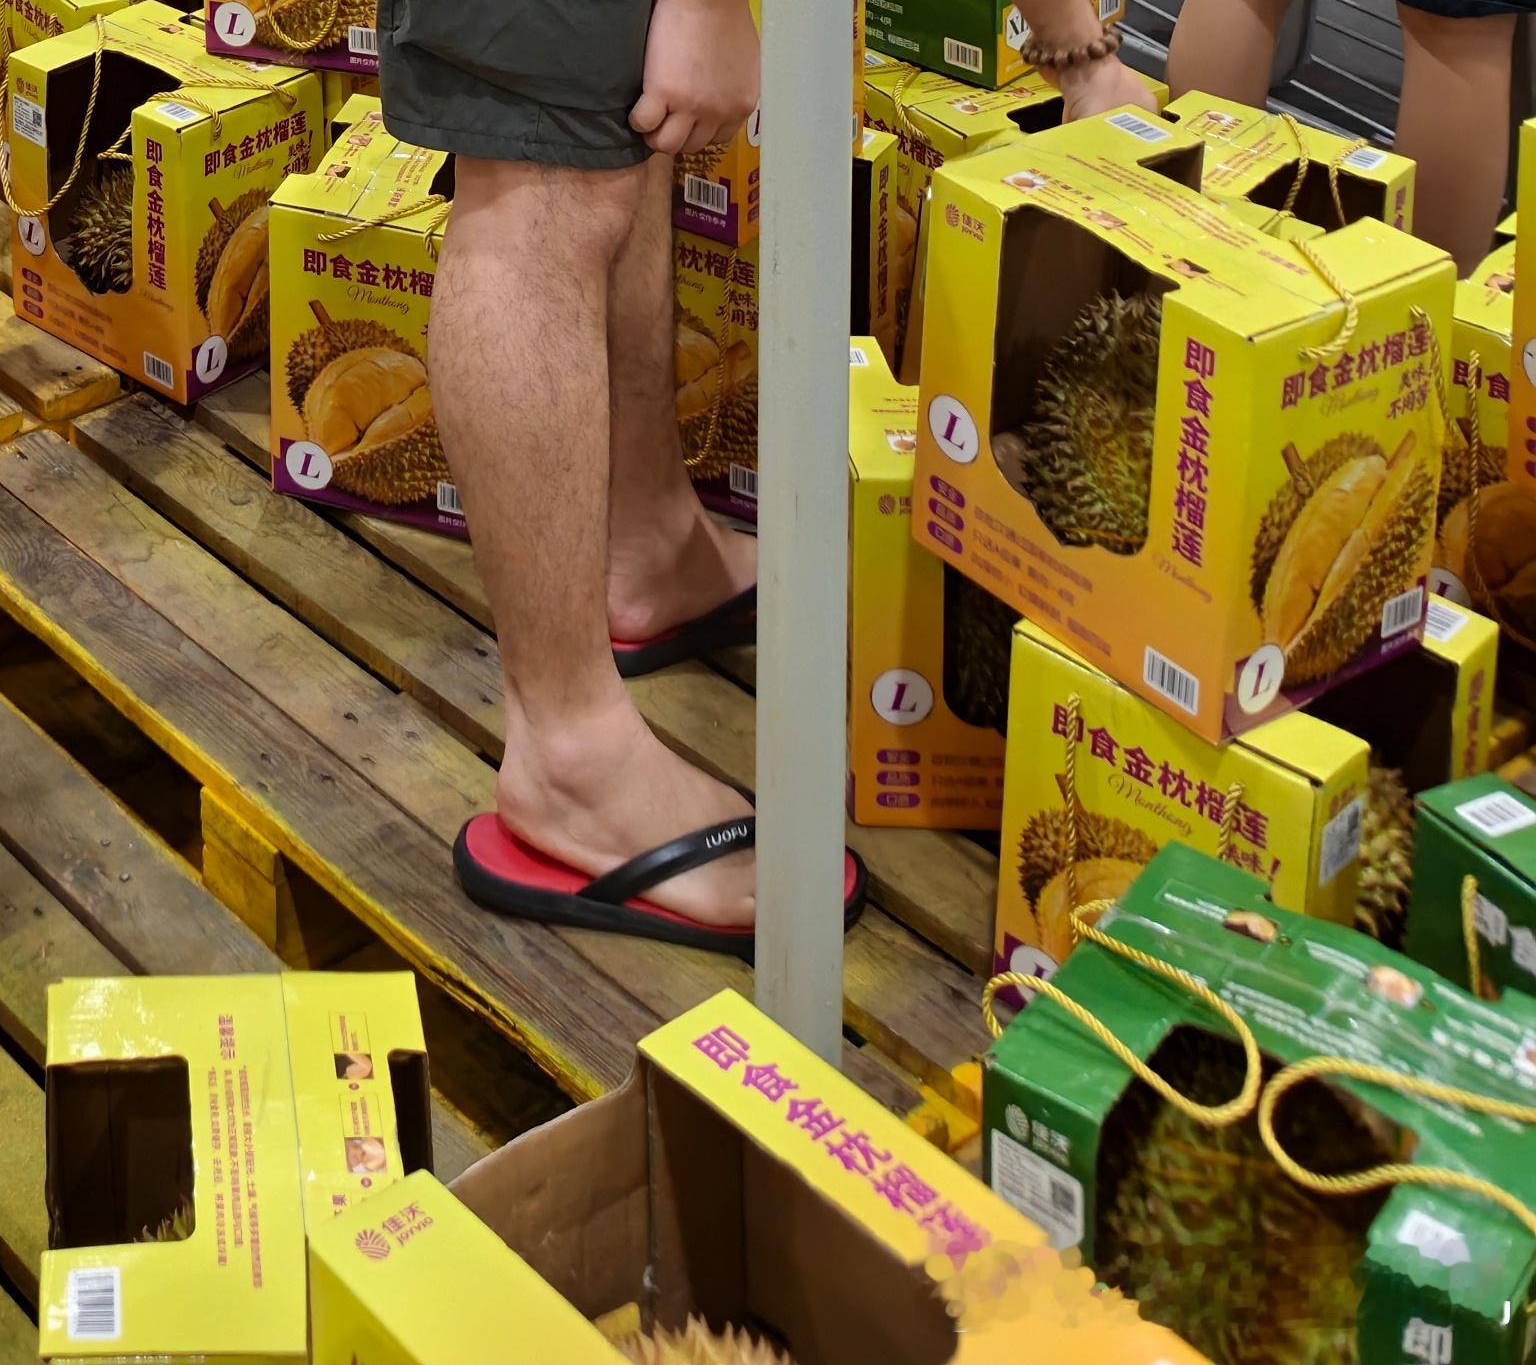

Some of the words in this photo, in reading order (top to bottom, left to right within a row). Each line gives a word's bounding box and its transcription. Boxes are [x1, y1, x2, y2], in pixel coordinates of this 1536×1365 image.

[204, 111, 307, 178] 即食金枕榴莲
[26, 221, 40, 247] L
[145, 137, 167, 291] 即食金枕榴莲
[1279, 321, 1432, 411] 即食金枕榴莲
[939, 411, 968, 448] L
[1170, 335, 1216, 567] 即食金枕榴莲
[297, 450, 325, 485] L
[891, 681, 918, 714] L
[1252, 658, 1272, 695] L
[1051, 702, 1270, 851] 即食金枕榴莲
